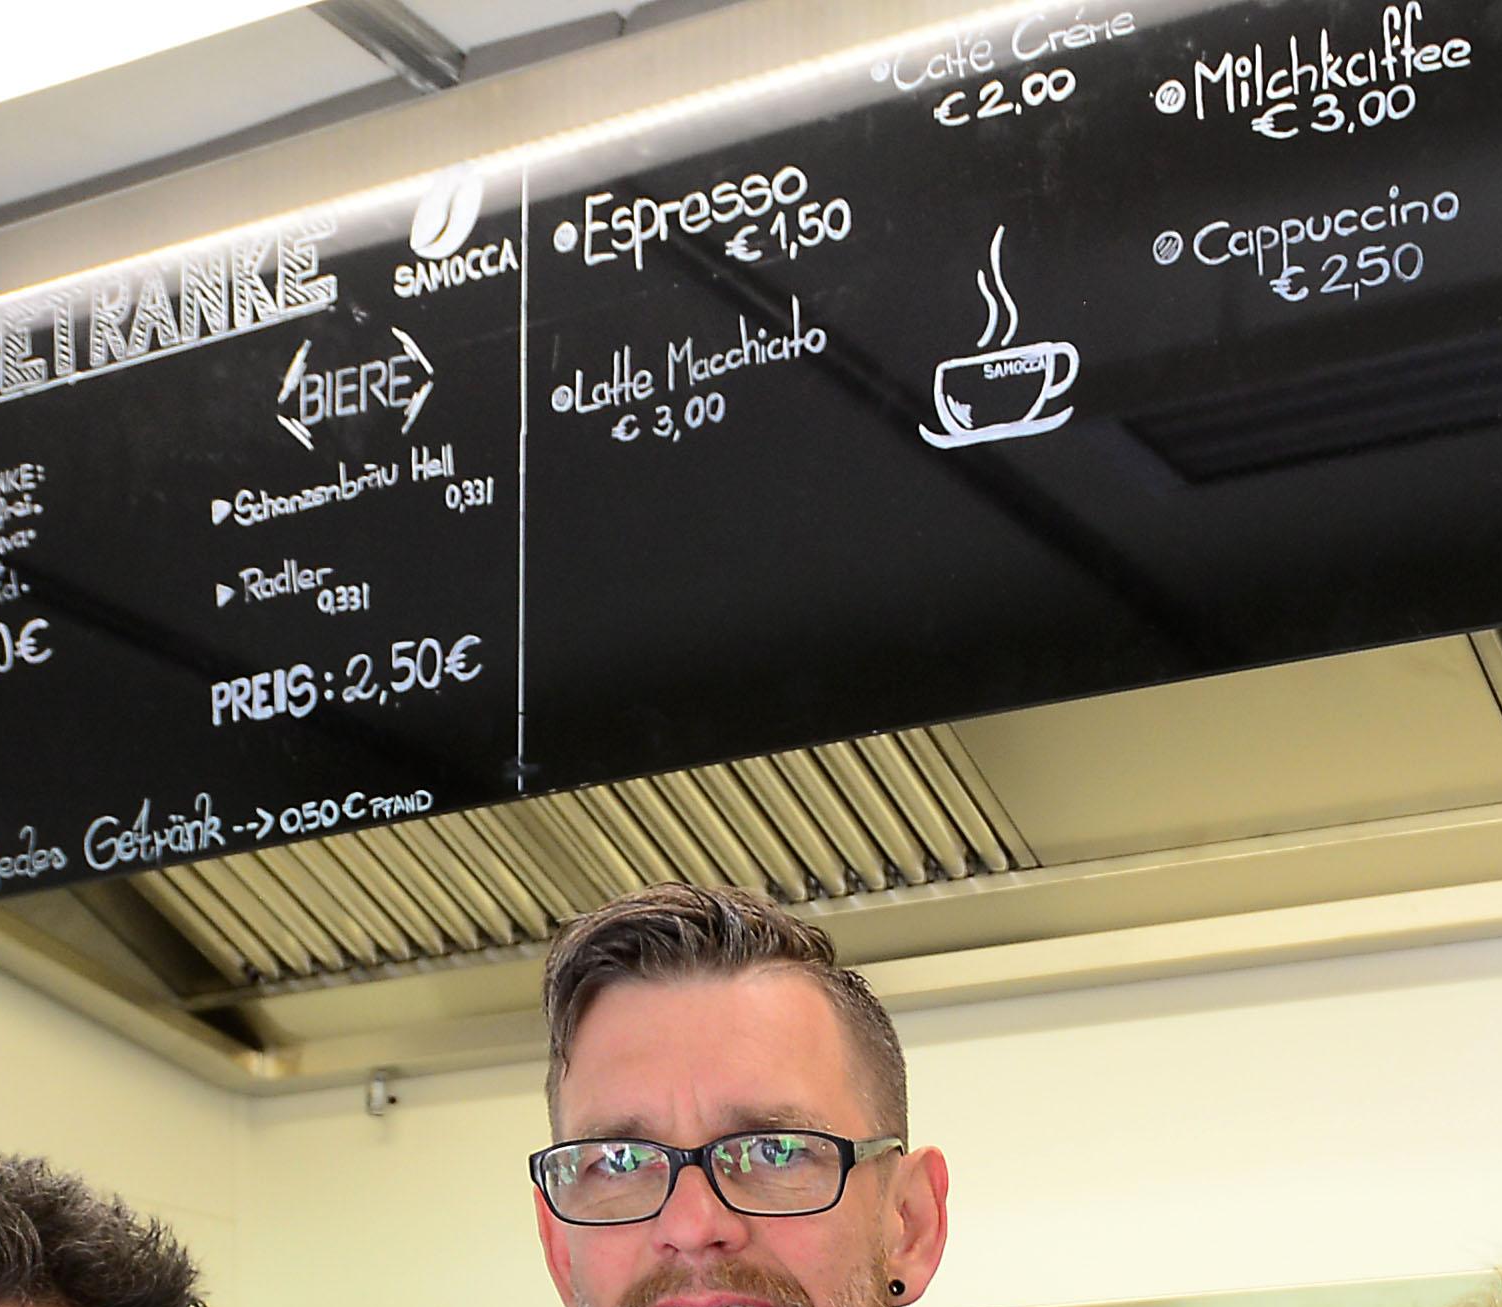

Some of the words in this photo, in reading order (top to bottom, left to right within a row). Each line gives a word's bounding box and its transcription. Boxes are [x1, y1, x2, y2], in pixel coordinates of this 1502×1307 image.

[1196, 1, 1473, 120] Milchkaffee
[934, 91, 970, 126] €
[977, 69, 1077, 119] 2,00
[1252, 102, 1299, 139] €
[1311, 84, 1417, 133] 3,00
[584, 165, 809, 272] Espresso
[725, 225, 763, 261] €
[770, 198, 852, 260] 1,50
[1193, 185, 1461, 275] Cappuccino
[394, 238, 518, 298] SAMOCCA
[1269, 266, 1309, 301] €
[1319, 242, 1424, 300] 2,50
[575, 345, 655, 413] Latte
[668, 294, 828, 391] Macchiato
[983, 355, 1047, 380] SAMOCCA
[299, 354, 416, 426] BIERE
[611, 414, 641, 442] €
[652, 392, 727, 442] 3,00
[411, 443, 455, 481] Hell
[238, 559, 334, 603] Radler
[84, 793, 227, 871] Getränk
[369, 789, 434, 819] PFAND
